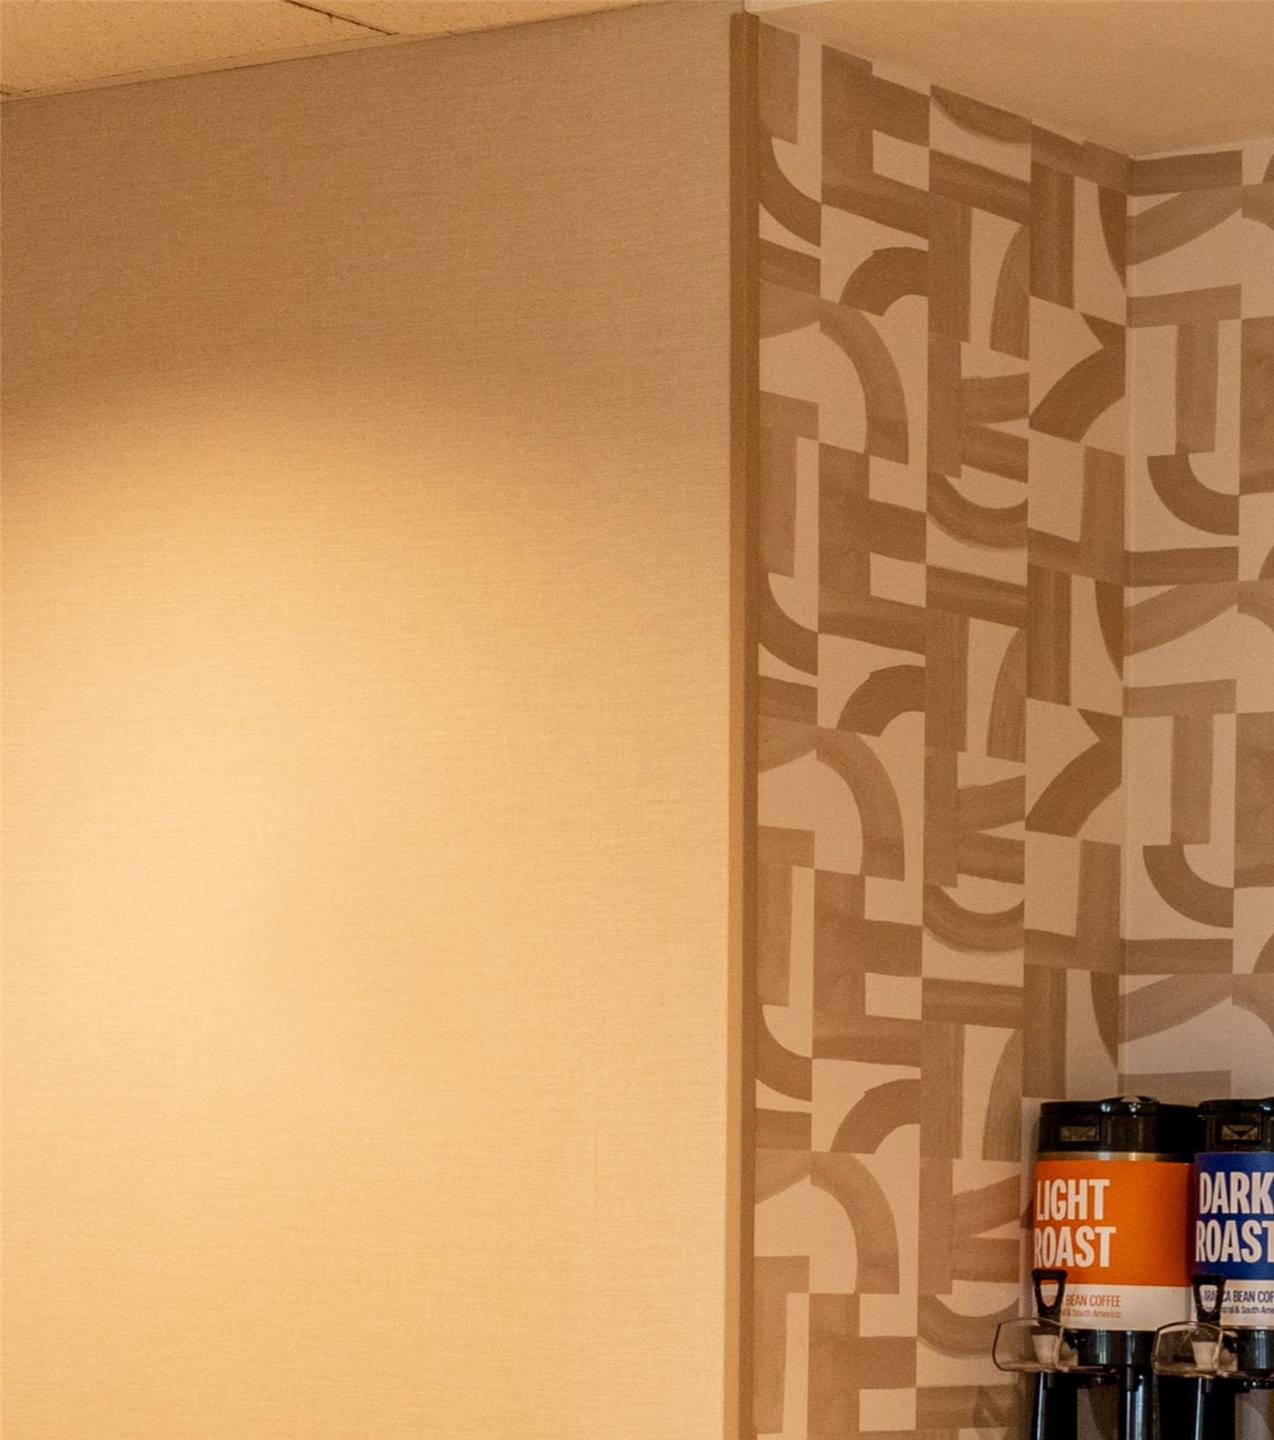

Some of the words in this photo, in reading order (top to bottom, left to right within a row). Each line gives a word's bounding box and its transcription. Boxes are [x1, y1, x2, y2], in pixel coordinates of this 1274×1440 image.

[1036, 1179, 1110, 1221] LIGHT
[1200, 1171, 1274, 1215] DARK
[1033, 1225, 1117, 1268] ROAST
[1066, 1294, 1088, 1306] BEAN
[1089, 1295, 1121, 1307] COFFEE
[1233, 1290, 1255, 1303] BEAN
